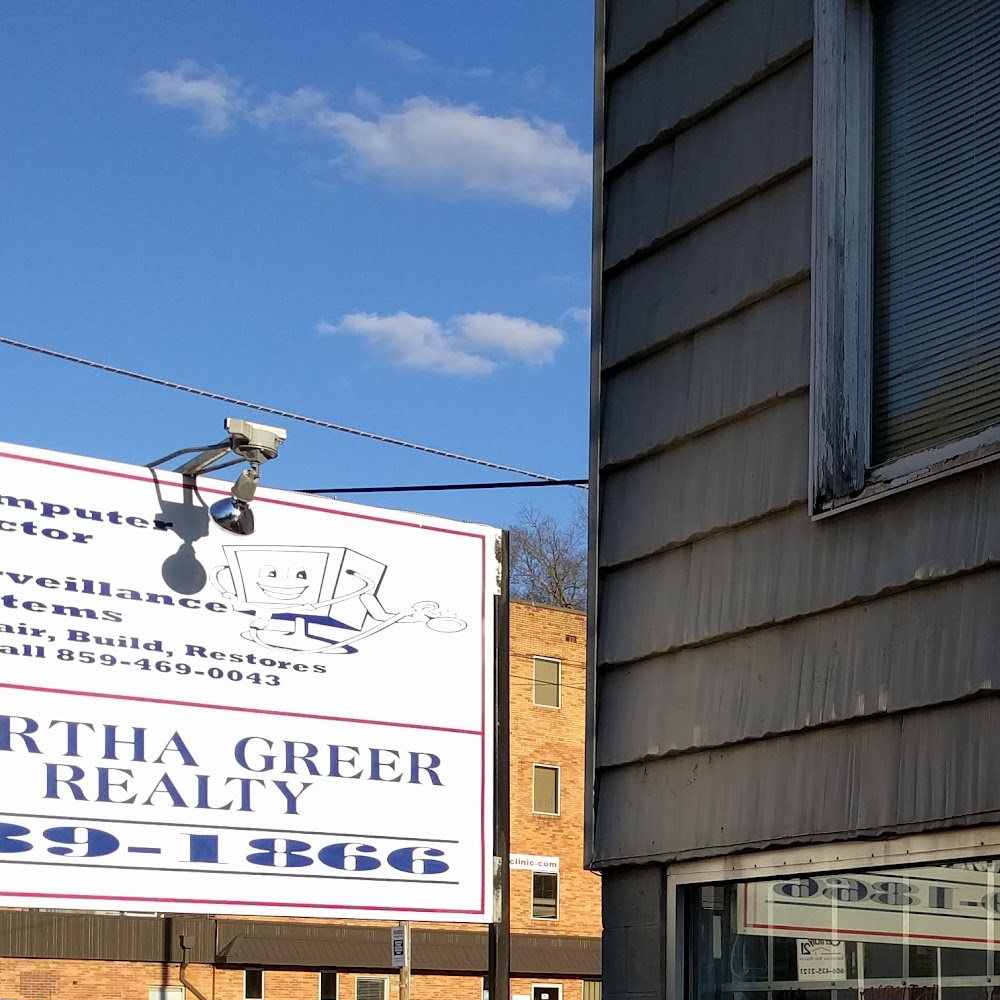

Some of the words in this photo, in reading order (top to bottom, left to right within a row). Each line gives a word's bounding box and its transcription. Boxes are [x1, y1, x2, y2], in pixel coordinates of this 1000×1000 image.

[0, 494, 173, 532] mputer
[0, 520, 93, 545] ctor
[0, 570, 228, 614] veillance
[0, 595, 123, 623] tems
[57, 649, 281, 687] 859-469-0043
[67, 629, 173, 658] Build,
[185, 644, 327, 674] Restores
[0, 715, 200, 767] RTHA
[235, 737, 446, 787] GREER
[42, 763, 314, 816] REALTY
